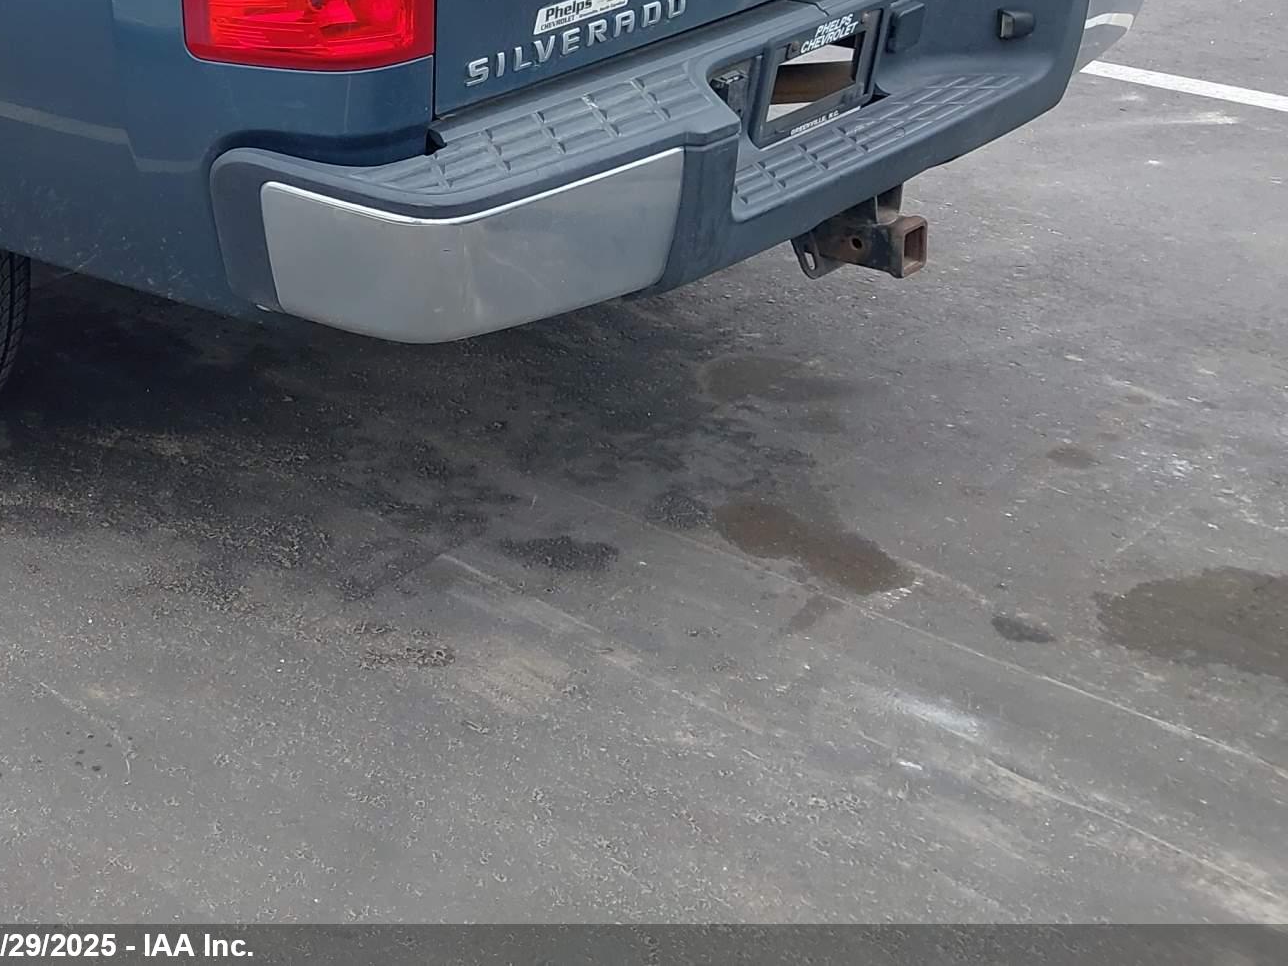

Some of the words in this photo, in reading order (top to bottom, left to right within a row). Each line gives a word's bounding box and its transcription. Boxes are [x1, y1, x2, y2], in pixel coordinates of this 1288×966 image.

[540, 16, 575, 31] CHEVROLET
[814, 13, 854, 38] PHELPS
[800, 20, 859, 54] CHEVROLET
